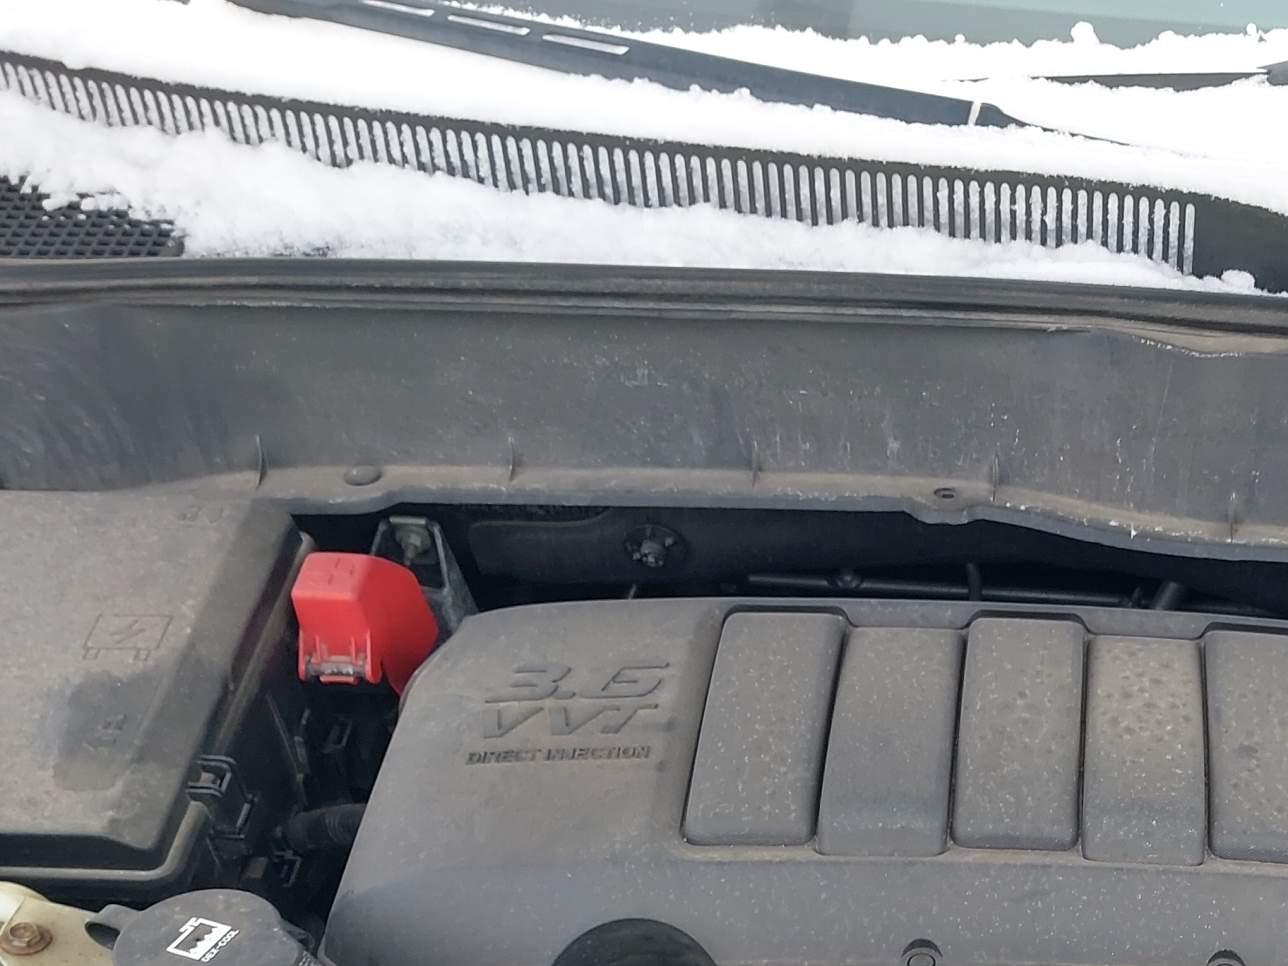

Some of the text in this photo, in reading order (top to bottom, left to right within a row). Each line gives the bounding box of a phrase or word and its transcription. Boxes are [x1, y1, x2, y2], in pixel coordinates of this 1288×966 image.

[484, 659, 671, 704] 3.6
[481, 702, 660, 739] VVT
[466, 746, 652, 765] DIRECT INJECTION
